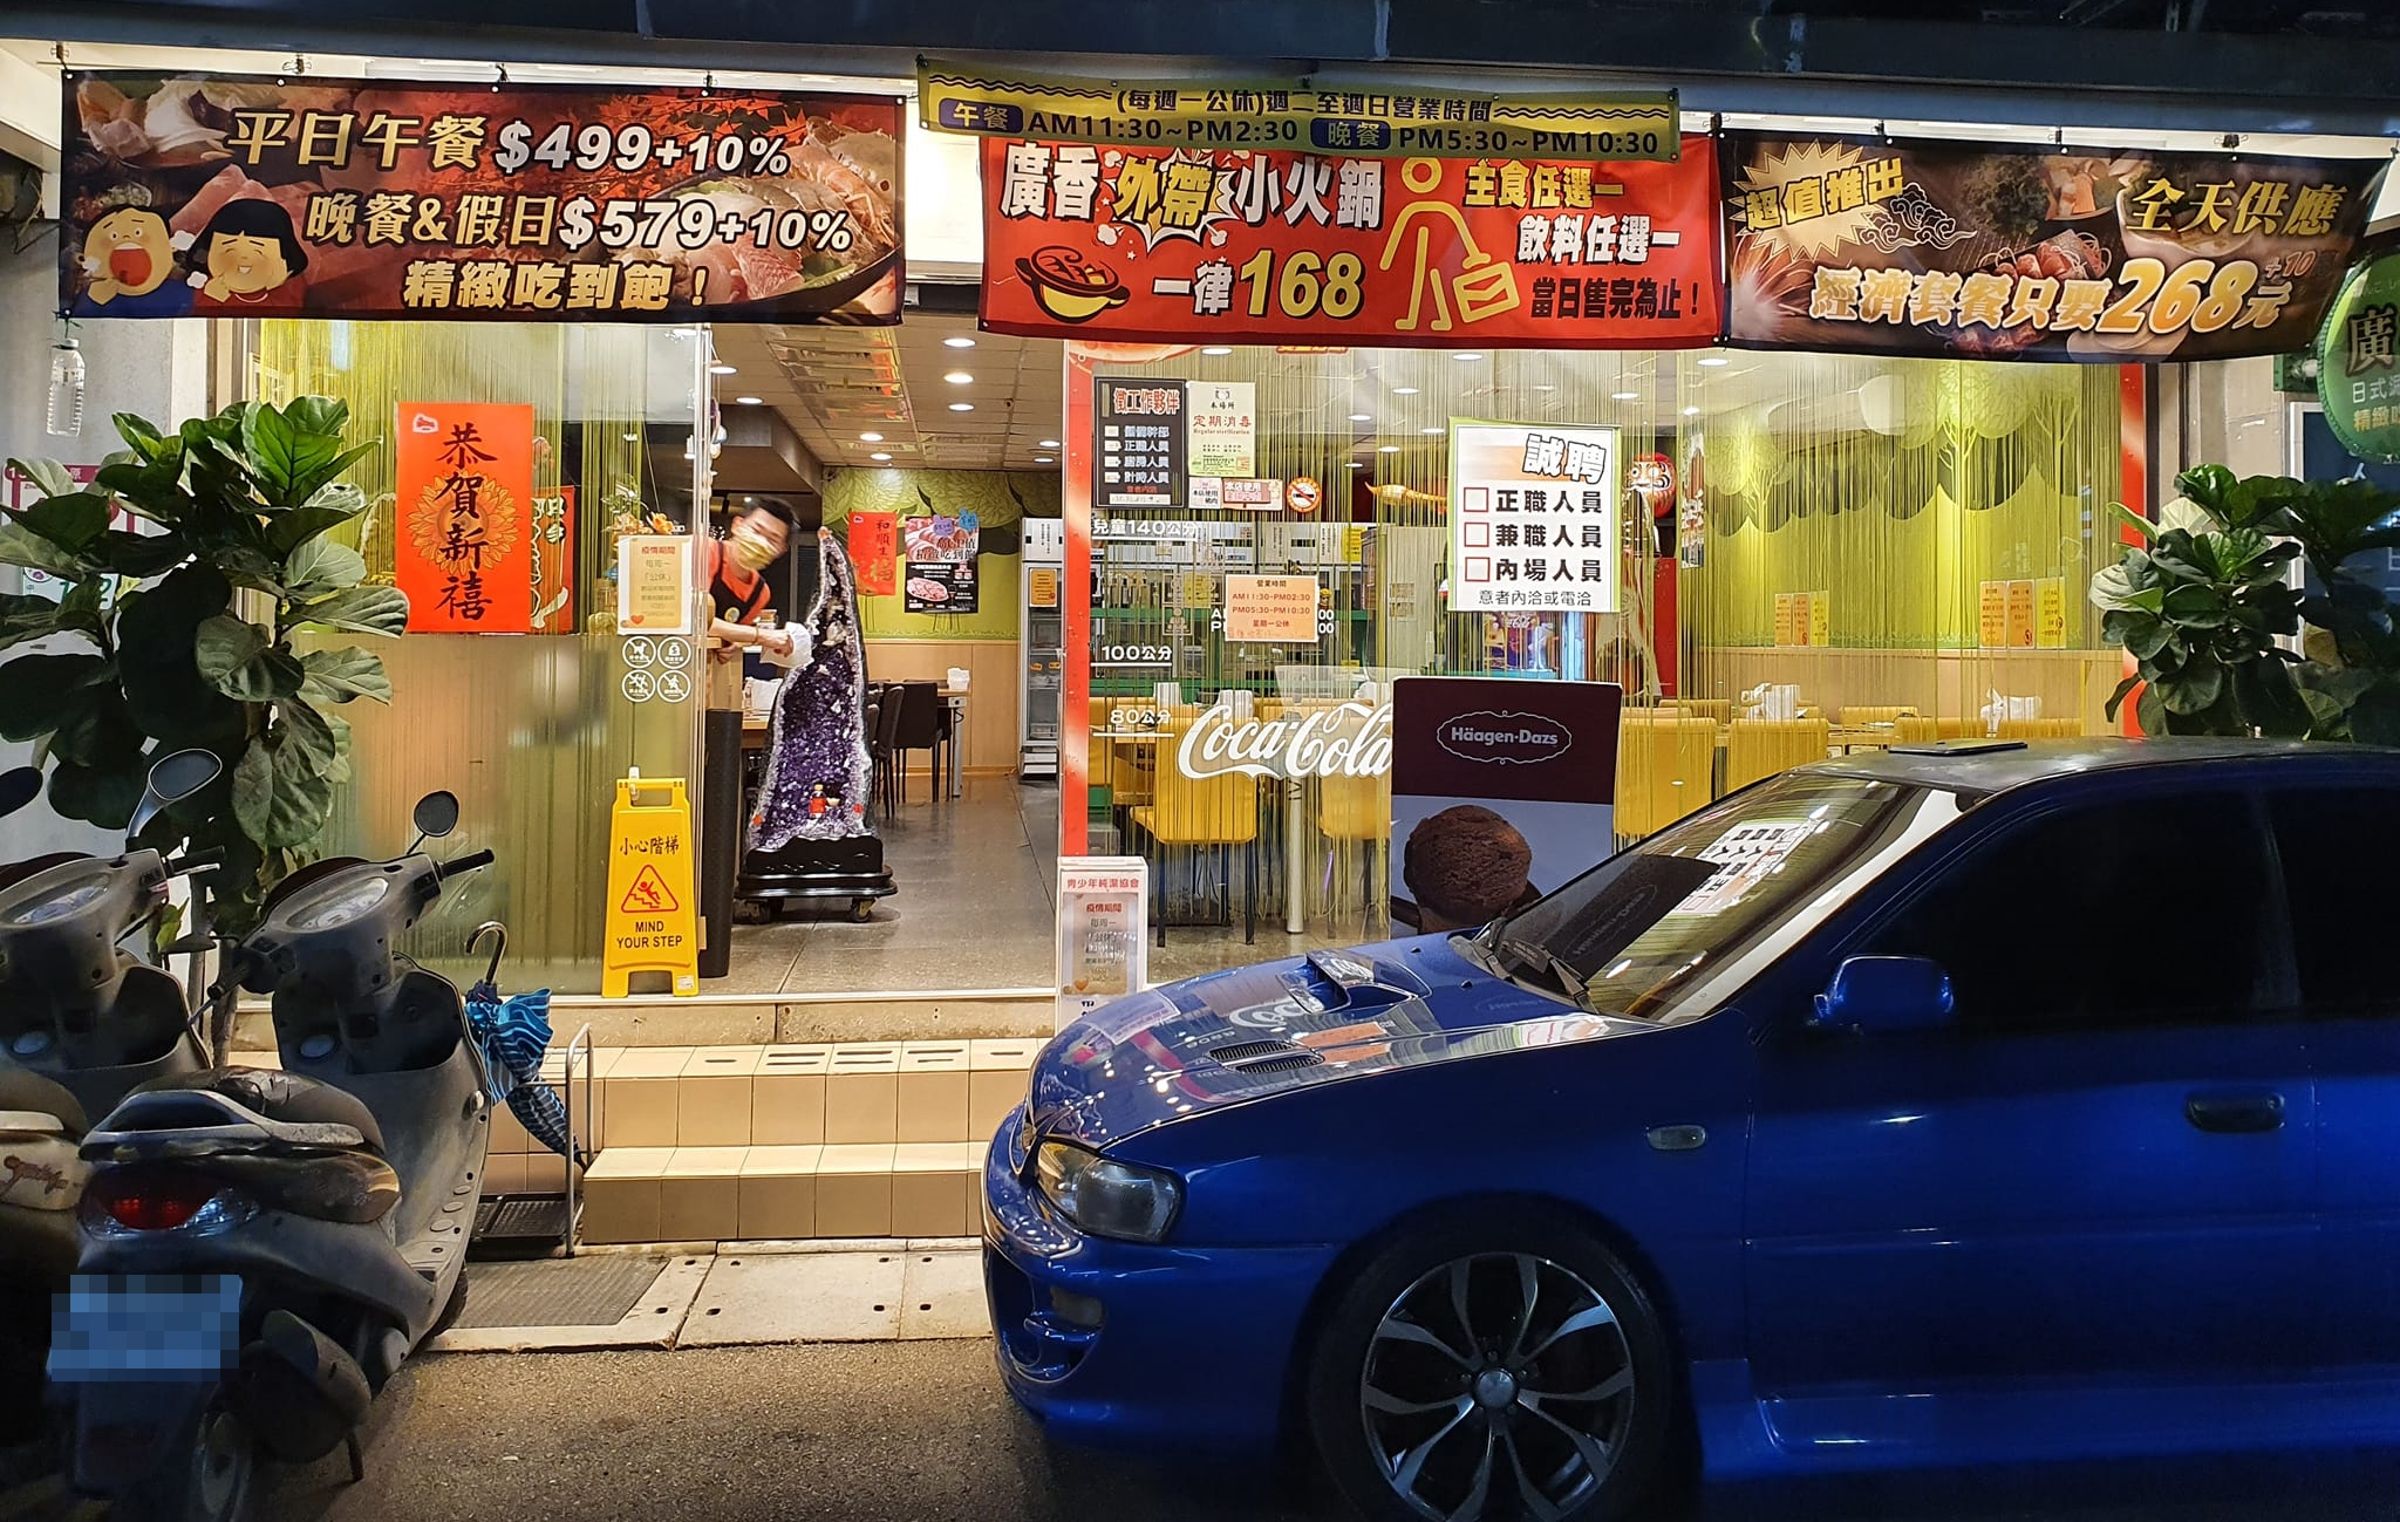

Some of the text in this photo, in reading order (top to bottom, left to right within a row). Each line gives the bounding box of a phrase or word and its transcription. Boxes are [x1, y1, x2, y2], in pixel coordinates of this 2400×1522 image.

[953, 102, 1009, 130] 午餐
[1027, 113, 1298, 142] AM11:30~PM2:30
[1328, 121, 1381, 148] 晚餐
[1400, 128, 1658, 154] PM5:30~PM10:30
[1465, 160, 1624, 207] 主食任選一
[1745, 158, 1904, 231] 超值推出
[2126, 178, 2348, 235] 全天供應
[1516, 215, 1681, 263] 飲料任選一
[1193, 415, 1252, 427] 定期消毒
[1522, 433, 1607, 484] 誠聘
[1495, 489, 1602, 513] 正職人員
[435, 422, 498, 621] 恭賀新禧
[1495, 524, 1602, 548] 兼職人員
[1495, 559, 1602, 582] 內場人員
[1232, 593, 1311, 601] AM11:30-PM02:30
[1478, 589, 1592, 607] 意者內洽或電洽
[1232, 606, 1311, 614] PM05:30-PM10:30
[1451, 726, 1559, 745] Häagen-Dazs
[620, 836, 679, 856] 小心階梯
[635, 920, 664, 932] MIND
[617, 935, 682, 949] YOUR STEP
